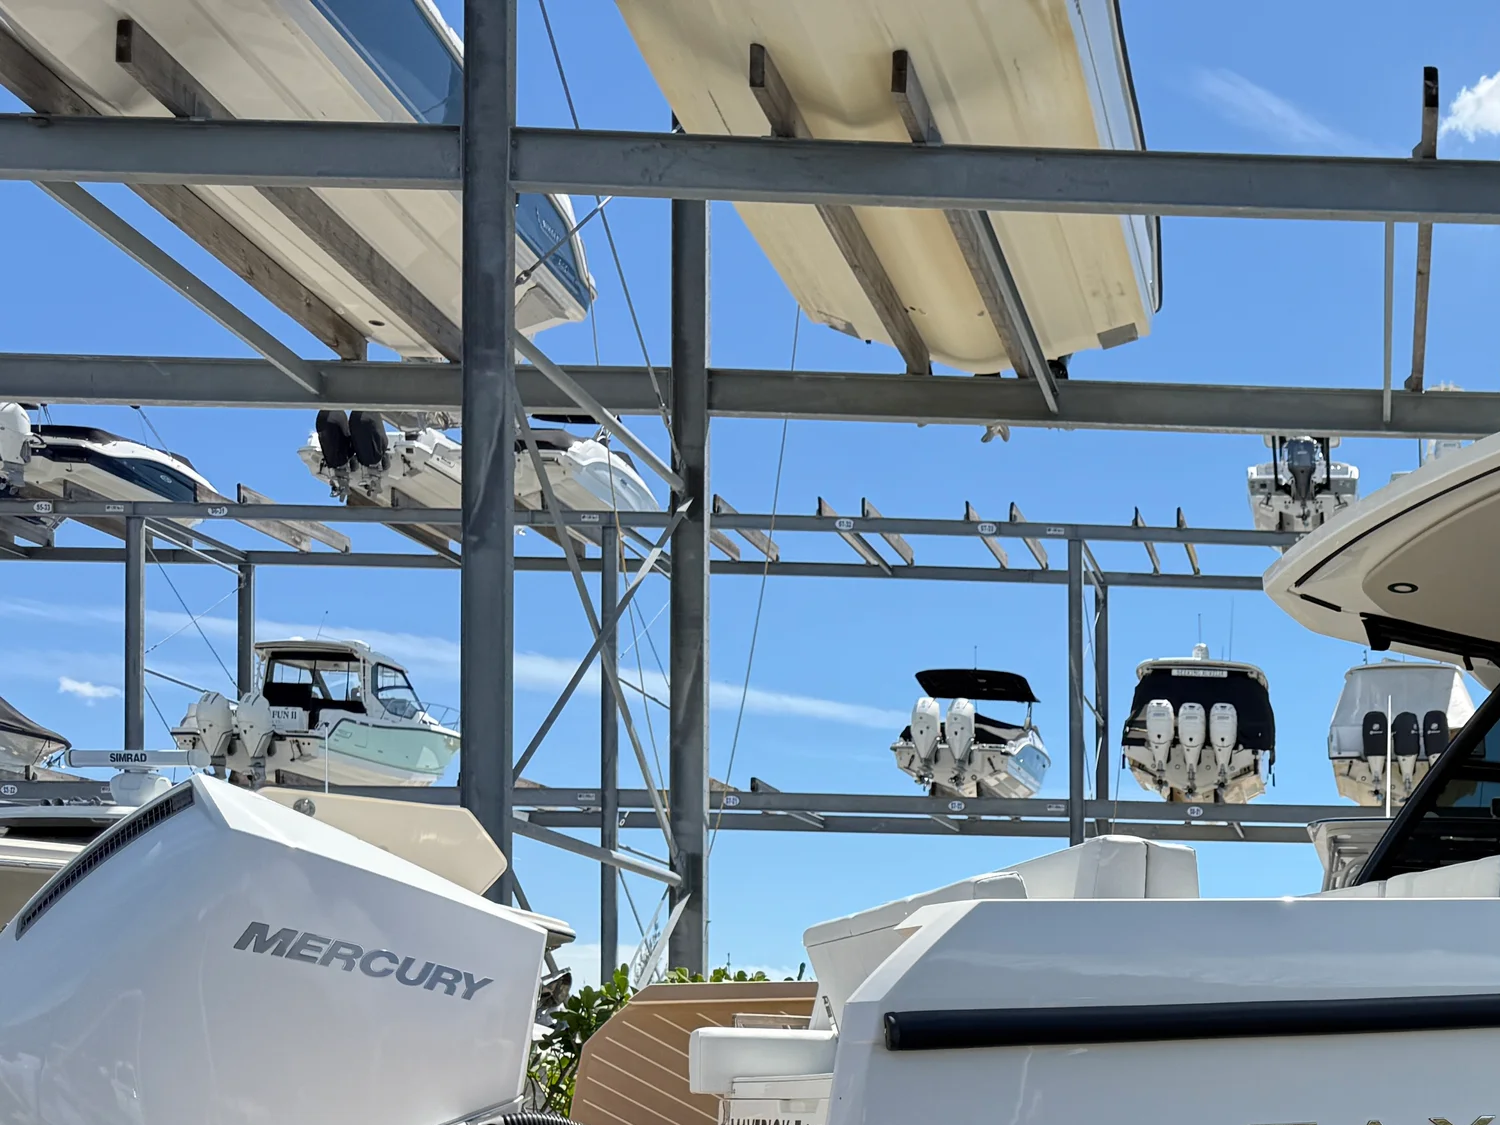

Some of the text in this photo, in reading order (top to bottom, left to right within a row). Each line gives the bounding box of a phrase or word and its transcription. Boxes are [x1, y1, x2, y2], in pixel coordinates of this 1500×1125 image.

[272, 710, 289, 720] FUN
[109, 752, 147, 763] SIMRAD
[233, 921, 494, 1001] MERCURY
